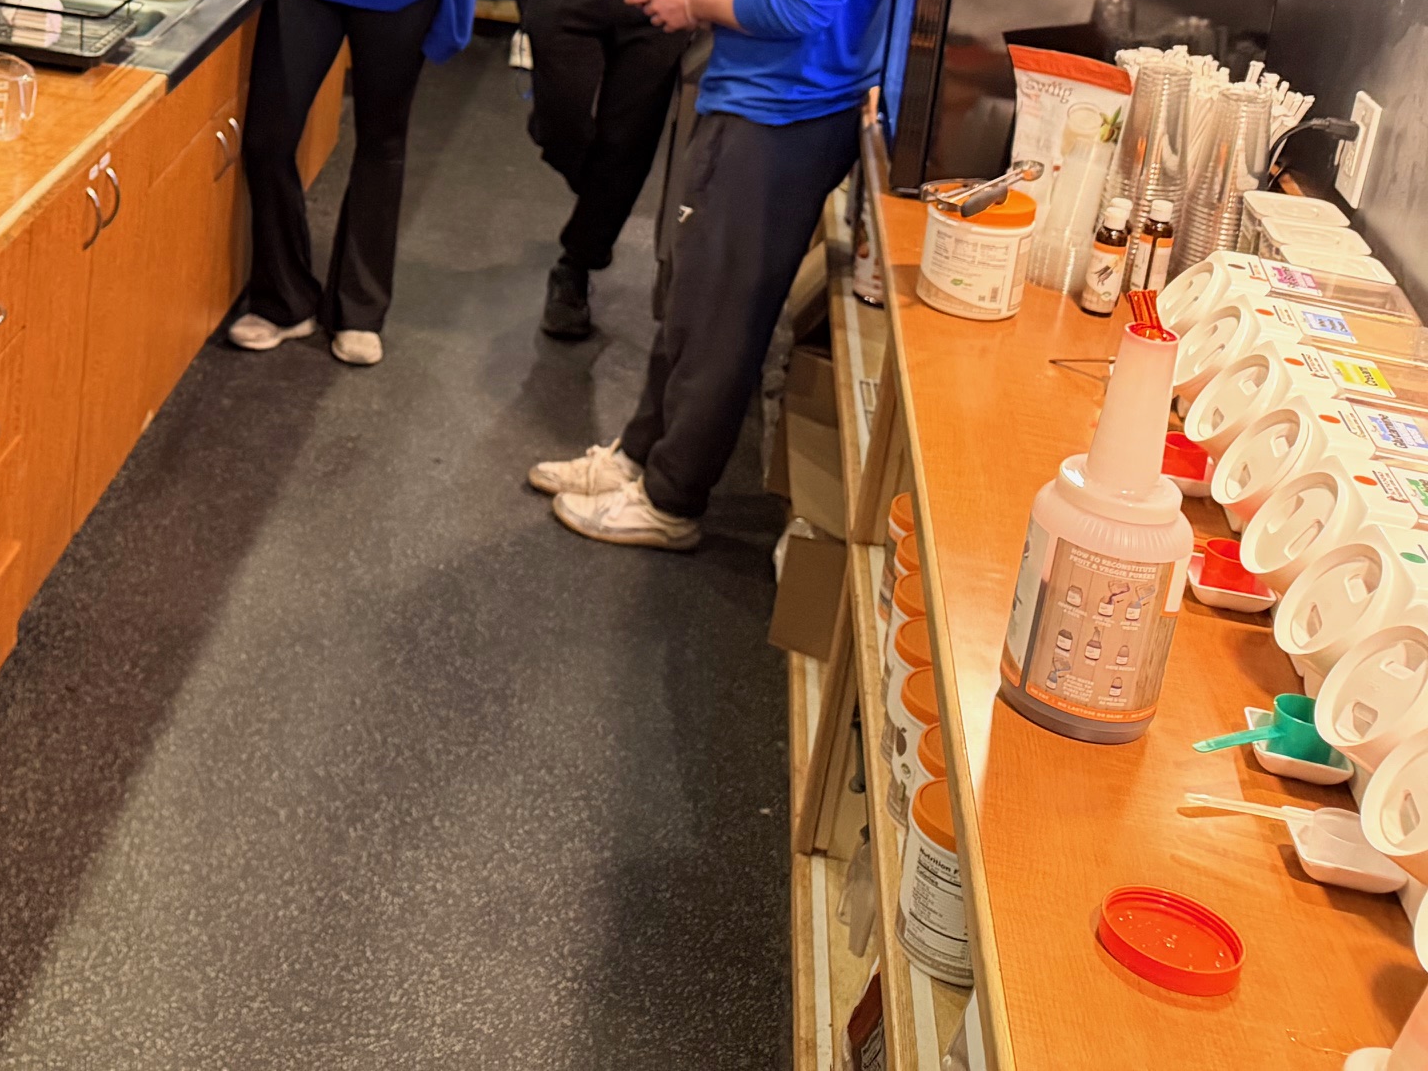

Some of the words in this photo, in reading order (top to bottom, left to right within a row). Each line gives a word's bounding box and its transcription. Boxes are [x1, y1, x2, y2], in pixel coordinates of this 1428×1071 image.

[1069, 554, 1091, 567] FRUIT
[1099, 565, 1128, 577] VEGGIE
[1070, 548, 1089, 559] HOW
[1089, 555, 1100, 564] TO
[1101, 557, 1158, 573] RECONSTITUTE
[919, 846, 952, 873] Nutrition
